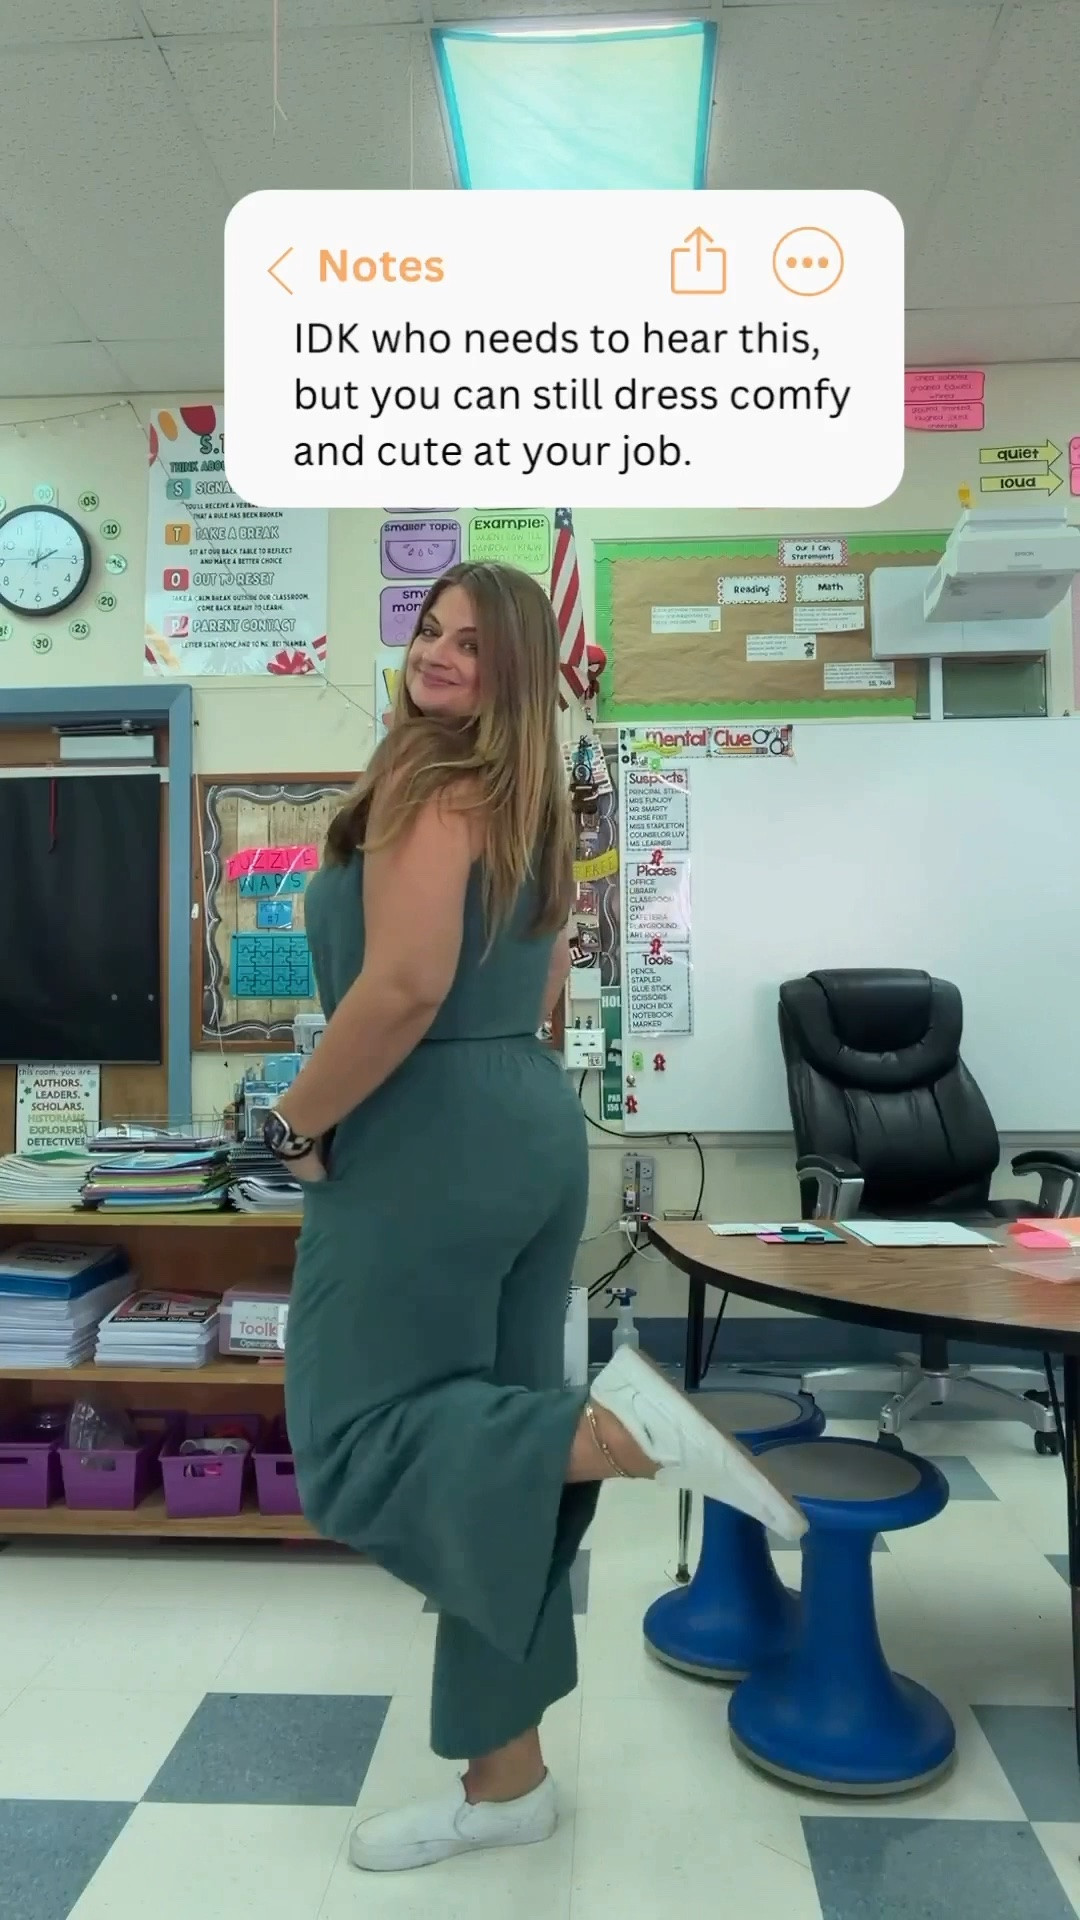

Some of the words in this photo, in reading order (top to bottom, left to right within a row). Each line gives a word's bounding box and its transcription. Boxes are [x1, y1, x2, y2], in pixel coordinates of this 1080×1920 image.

[997, 449, 1040, 461] quiet
[169, 461, 199, 472] THINK
[195, 481, 236, 494] SIGNA
[1000, 477, 1036, 489] loud
[174, 480, 184, 497] S
[474, 519, 544, 530] Example:
[172, 527, 182, 542] T
[196, 527, 226, 540] TAKE
[228, 526, 238, 540] A
[239, 525, 280, 540] BREAK
[795, 544, 808, 552] Our
[818, 544, 831, 552] Can
[71, 556, 78, 565] 3
[3, 577, 9, 586] 8
[64, 574, 71, 583] 4
[193, 572, 217, 586] OUT
[219, 572, 235, 586] TO
[236, 572, 275, 586] RESET
[734, 584, 770, 597] Reading
[818, 582, 844, 591] Math
[19, 589, 25, 598] 7
[53, 587, 59, 597] 5
[35, 594, 42, 602] 6
[193, 619, 239, 632] PARENT
[241, 618, 296, 632] CONTACT
[714, 729, 752, 747] Clue
[629, 831, 671, 839] COUNSELOR
[636, 864, 677, 876] Places
[642, 954, 674, 966] Tools
[631, 967, 656, 975] PENCIL
[651, 984, 672, 992] STICK
[601, 995, 622, 1008] HOL
[632, 993, 667, 1001] SCISSORS
[632, 1011, 673, 1019] NOTEBOOK
[18, 1068, 33, 1076] this
[33, 1079, 83, 1088] AUTHORS.
[35, 1090, 81, 1099] LEADERS.
[31, 1102, 84, 1111] SCHOLARS.
[240, 1321, 278, 1337] Toolk
